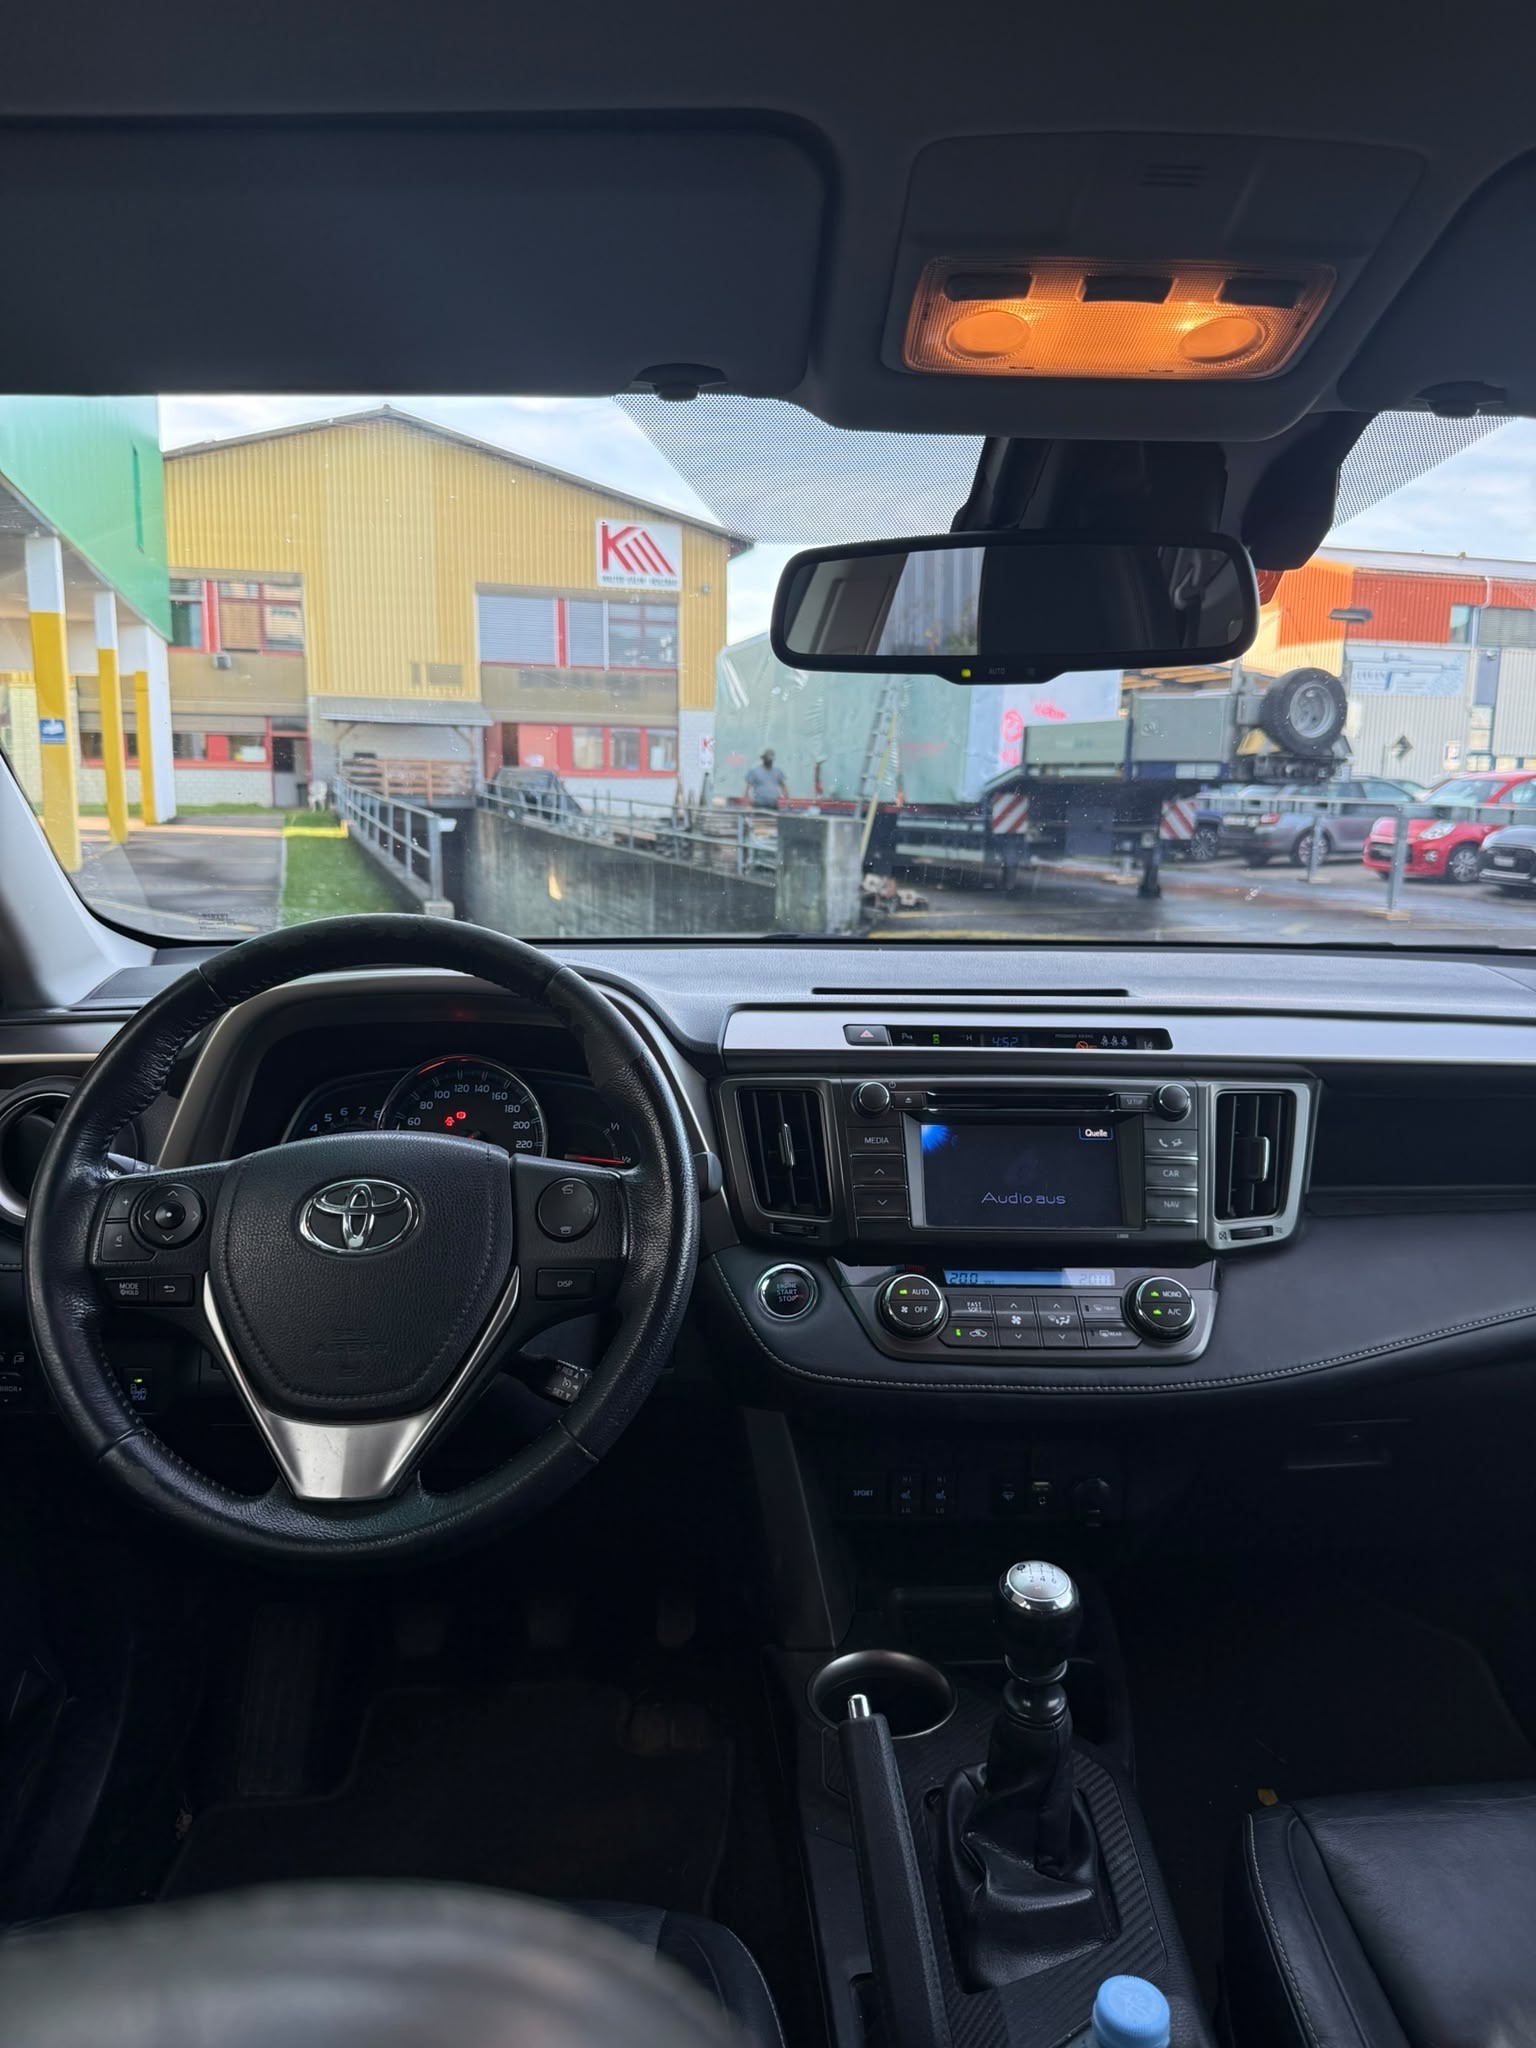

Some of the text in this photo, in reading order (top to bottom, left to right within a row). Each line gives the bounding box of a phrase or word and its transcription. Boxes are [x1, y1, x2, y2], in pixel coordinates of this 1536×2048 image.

[988, 667, 1005, 675] AUTO
[992, 1036, 1018, 1047] 4:52
[454, 1084, 470, 1093] 120
[474, 1084, 490, 1093] 140
[434, 1090, 450, 1099] 100
[491, 1091, 508, 1100] 160
[420, 1101, 434, 1110] 80
[504, 1104, 520, 1113] 180
[340, 1107, 349, 1116] 6
[358, 1106, 367, 1115] 7
[324, 1113, 333, 1122] 5
[407, 1117, 421, 1126] 60
[309, 1123, 318, 1132] 4
[513, 1120, 530, 1129] 200
[1084, 1129, 1108, 1138] Quelle
[515, 1140, 533, 1149] 220
[864, 1136, 889, 1144] MEDIA
[1162, 1169, 1180, 1178] CAR
[981, 1191, 1066, 1205] Audio aus
[1163, 1200, 1180, 1209] NAV
[556, 1280, 573, 1288] DISP
[778, 1295, 797, 1303] STOP
[1167, 1308, 1181, 1316] A/C
